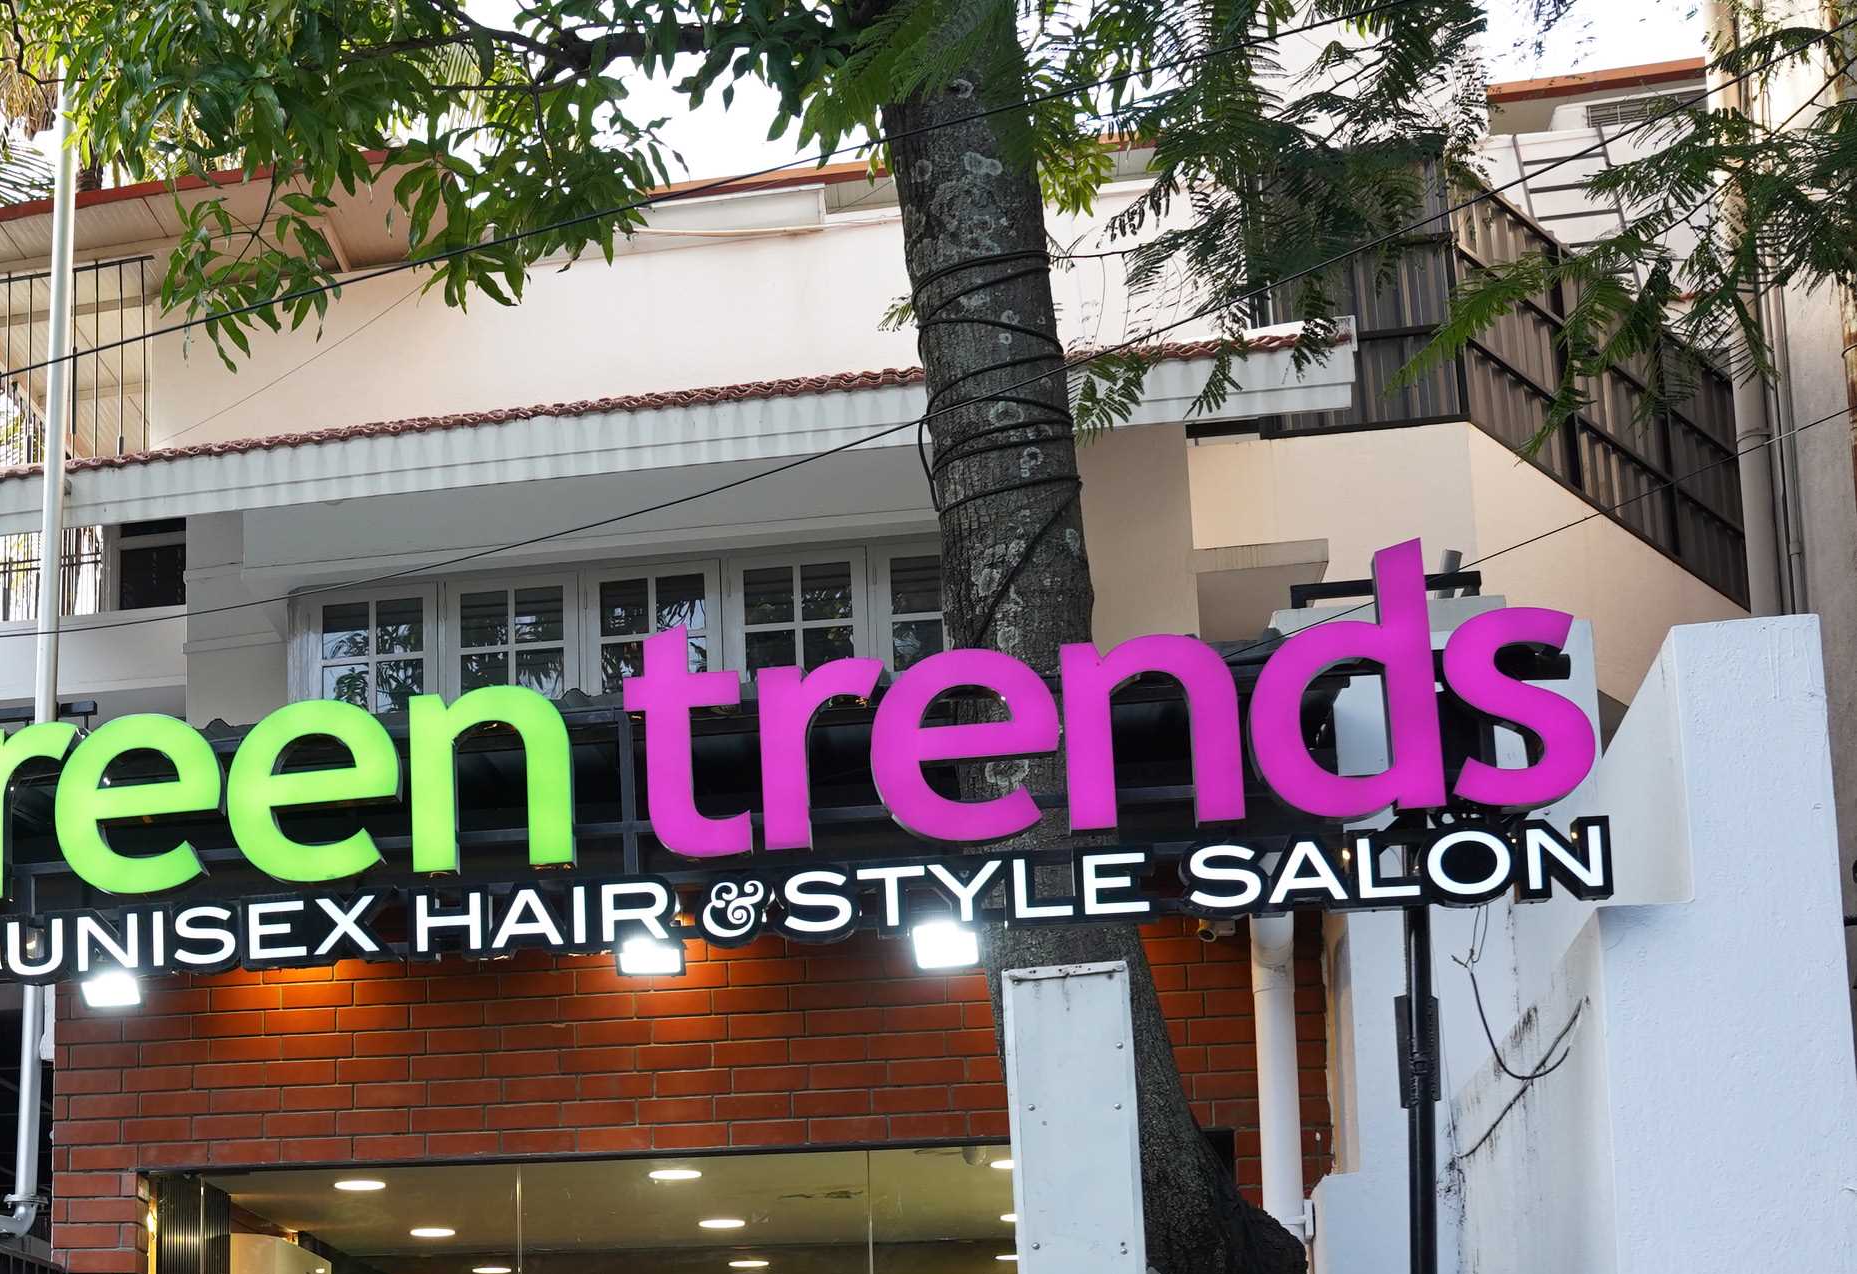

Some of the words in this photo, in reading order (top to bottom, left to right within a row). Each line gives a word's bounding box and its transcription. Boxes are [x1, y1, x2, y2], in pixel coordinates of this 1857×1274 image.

[623, 538, 1597, 857] trends
[7, 893, 377, 977] UNISEX
[416, 880, 674, 955] HAIR
[701, 878, 770, 938] &
[784, 852, 1150, 934] STYLE
[1188, 815, 1605, 908] SALON
